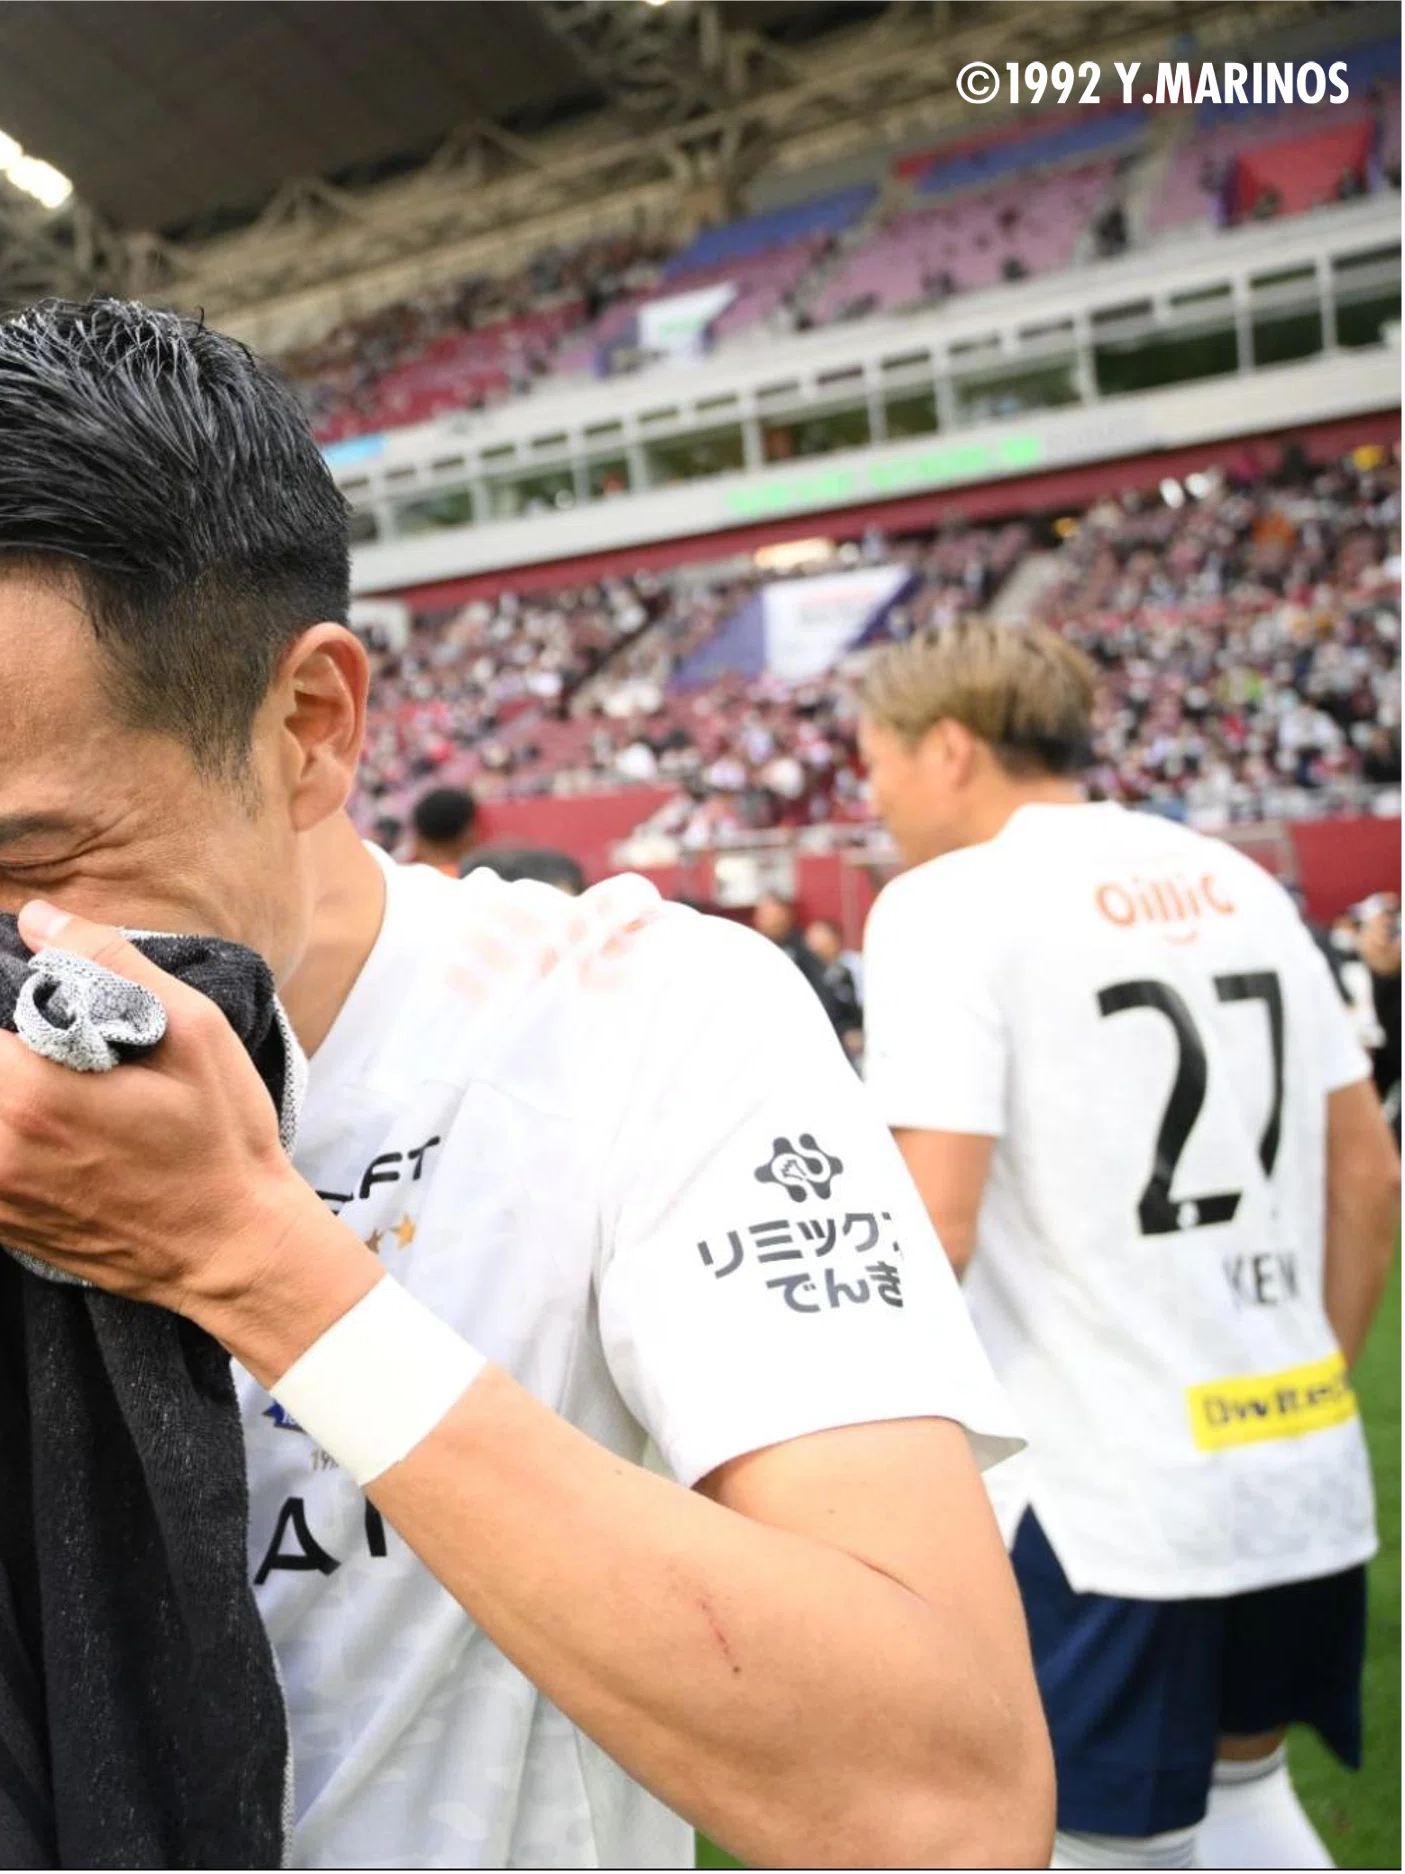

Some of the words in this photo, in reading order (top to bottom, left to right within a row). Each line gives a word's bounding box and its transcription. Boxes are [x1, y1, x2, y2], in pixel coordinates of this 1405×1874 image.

[1095, 971, 1283, 1236] 27
[765, 1261, 904, 1313] でんき
